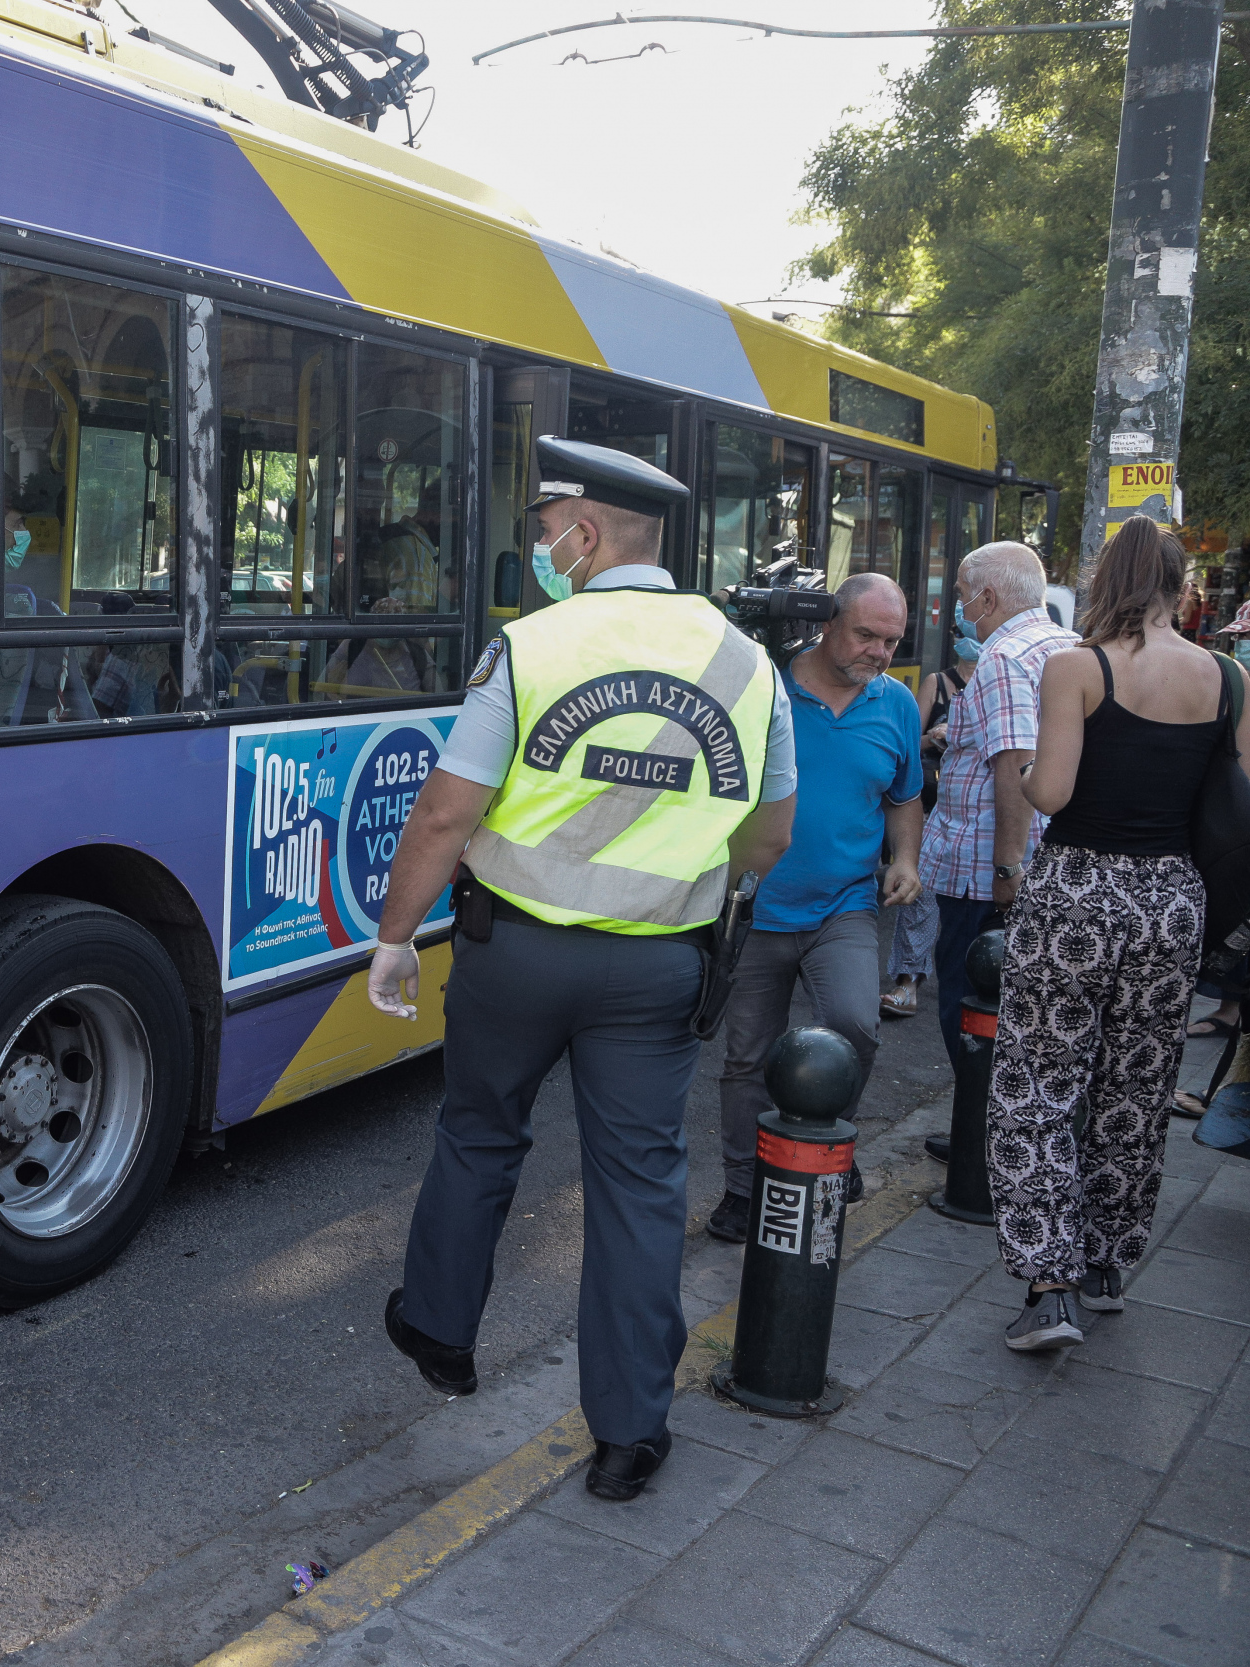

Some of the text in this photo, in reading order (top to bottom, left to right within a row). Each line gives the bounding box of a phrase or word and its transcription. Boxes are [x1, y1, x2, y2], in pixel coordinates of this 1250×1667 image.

[1122, 465, 1174, 486] ΕΝΟΙ
[530, 680, 741, 793] ΕΛΛΗΝΙΚΗ ΑΣΤΥΝΟΜΙΑ
[374, 750, 429, 787] 102.5
[600, 754, 678, 784] POLICE
[253, 747, 336, 850] 102.5 fm
[355, 791, 420, 831] ATHE
[265, 819, 323, 907] RADIO
[365, 829, 402, 865] VO
[366, 872, 389, 903] RA
[246, 924, 329, 952] το Soundtrack της πόλης
[262, 920, 283, 934] Φωνή
[283, 919, 295, 928] της
[296, 912, 322, 926] Αθήνας
[762, 1183, 802, 1250] BNE
